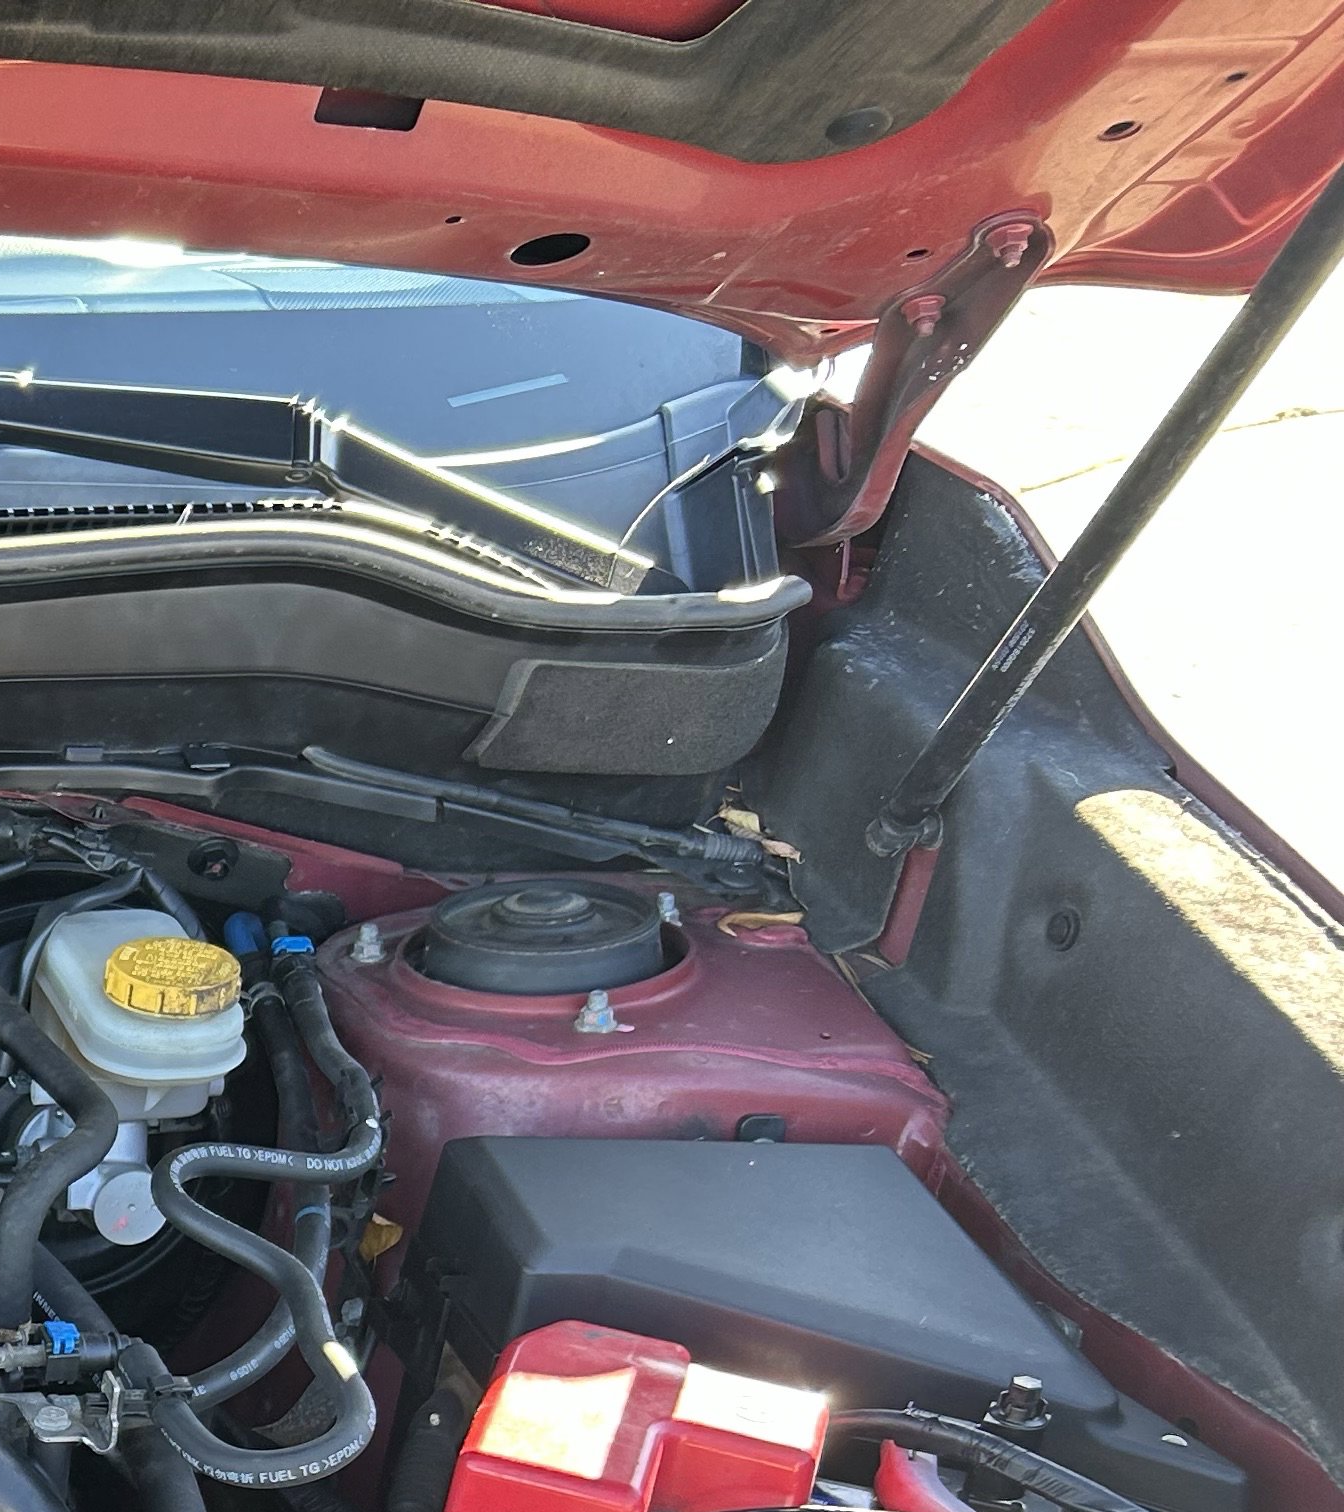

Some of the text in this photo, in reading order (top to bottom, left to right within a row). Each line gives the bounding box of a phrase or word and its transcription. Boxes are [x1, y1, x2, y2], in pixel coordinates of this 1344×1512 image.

[210, 1145, 235, 1158] FUEL
[306, 1157, 322, 1170] DO
[324, 1157, 345, 1171] NOT
[258, 1468, 297, 1484] FUEL
[299, 1461, 321, 1477] TG
